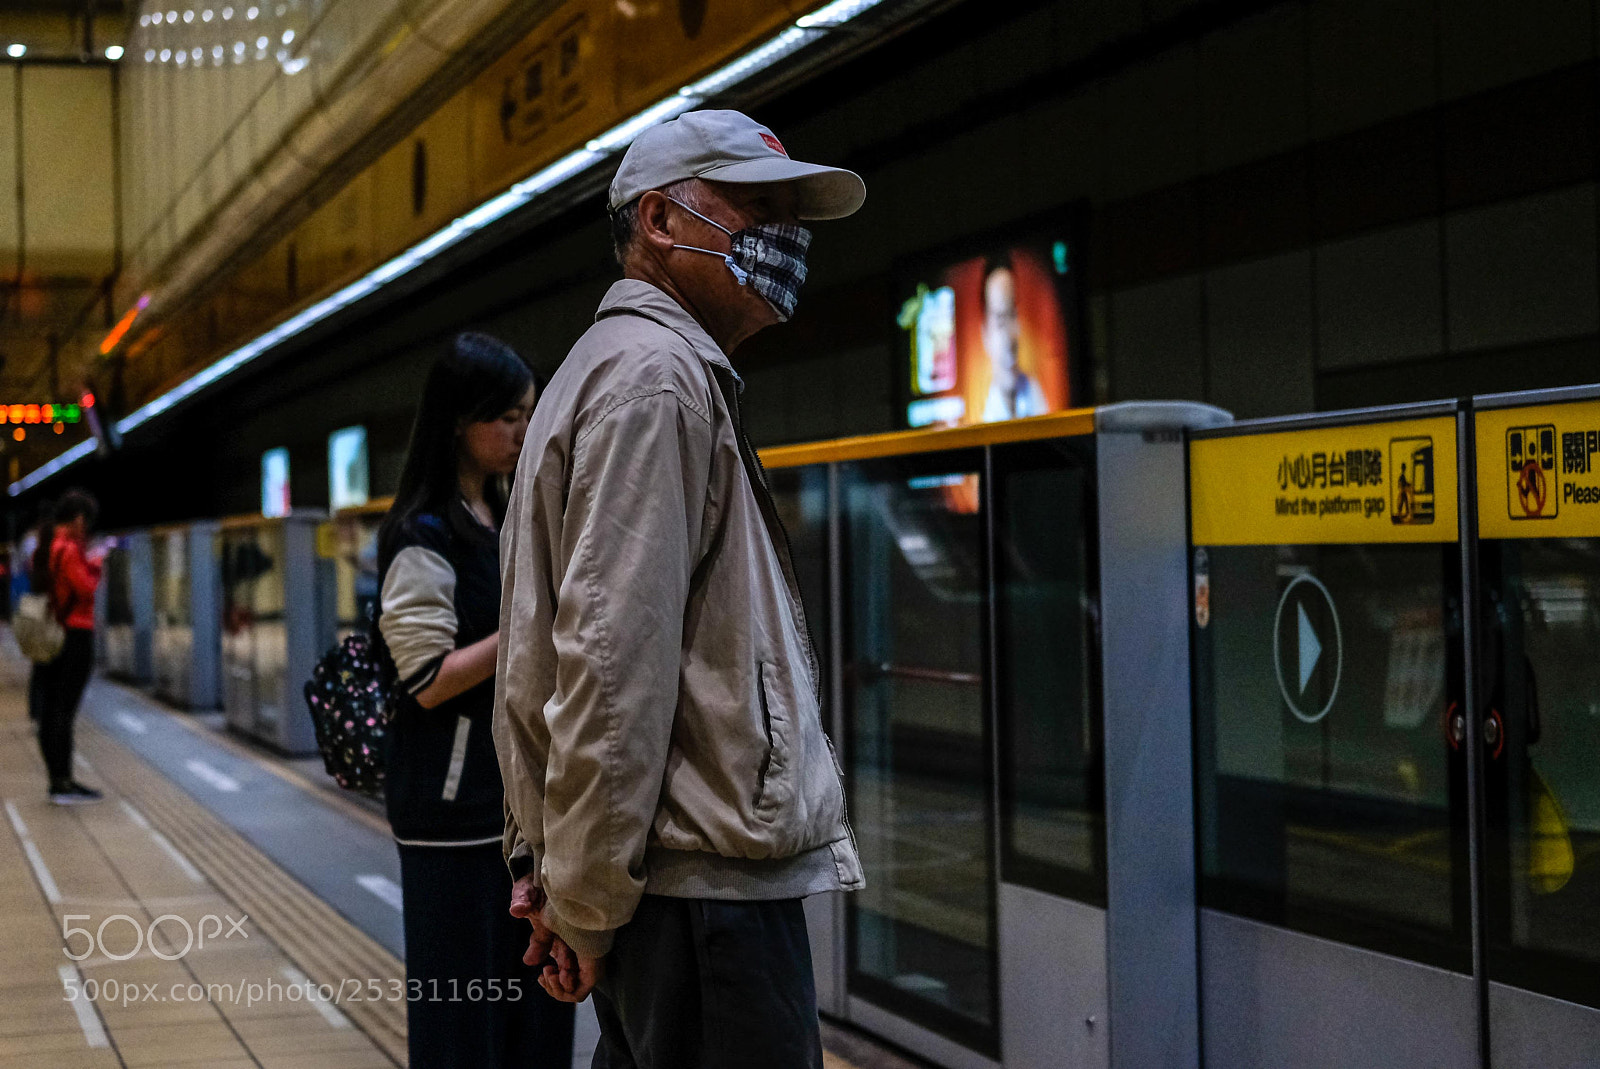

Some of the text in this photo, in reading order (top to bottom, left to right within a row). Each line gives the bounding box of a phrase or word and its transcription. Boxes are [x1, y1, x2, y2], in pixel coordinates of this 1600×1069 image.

[1277, 448, 1382, 490] 小心月台間隙
[1563, 482, 1600, 504] Pleas
[1275, 496, 1385, 520] Mind the platform gap
